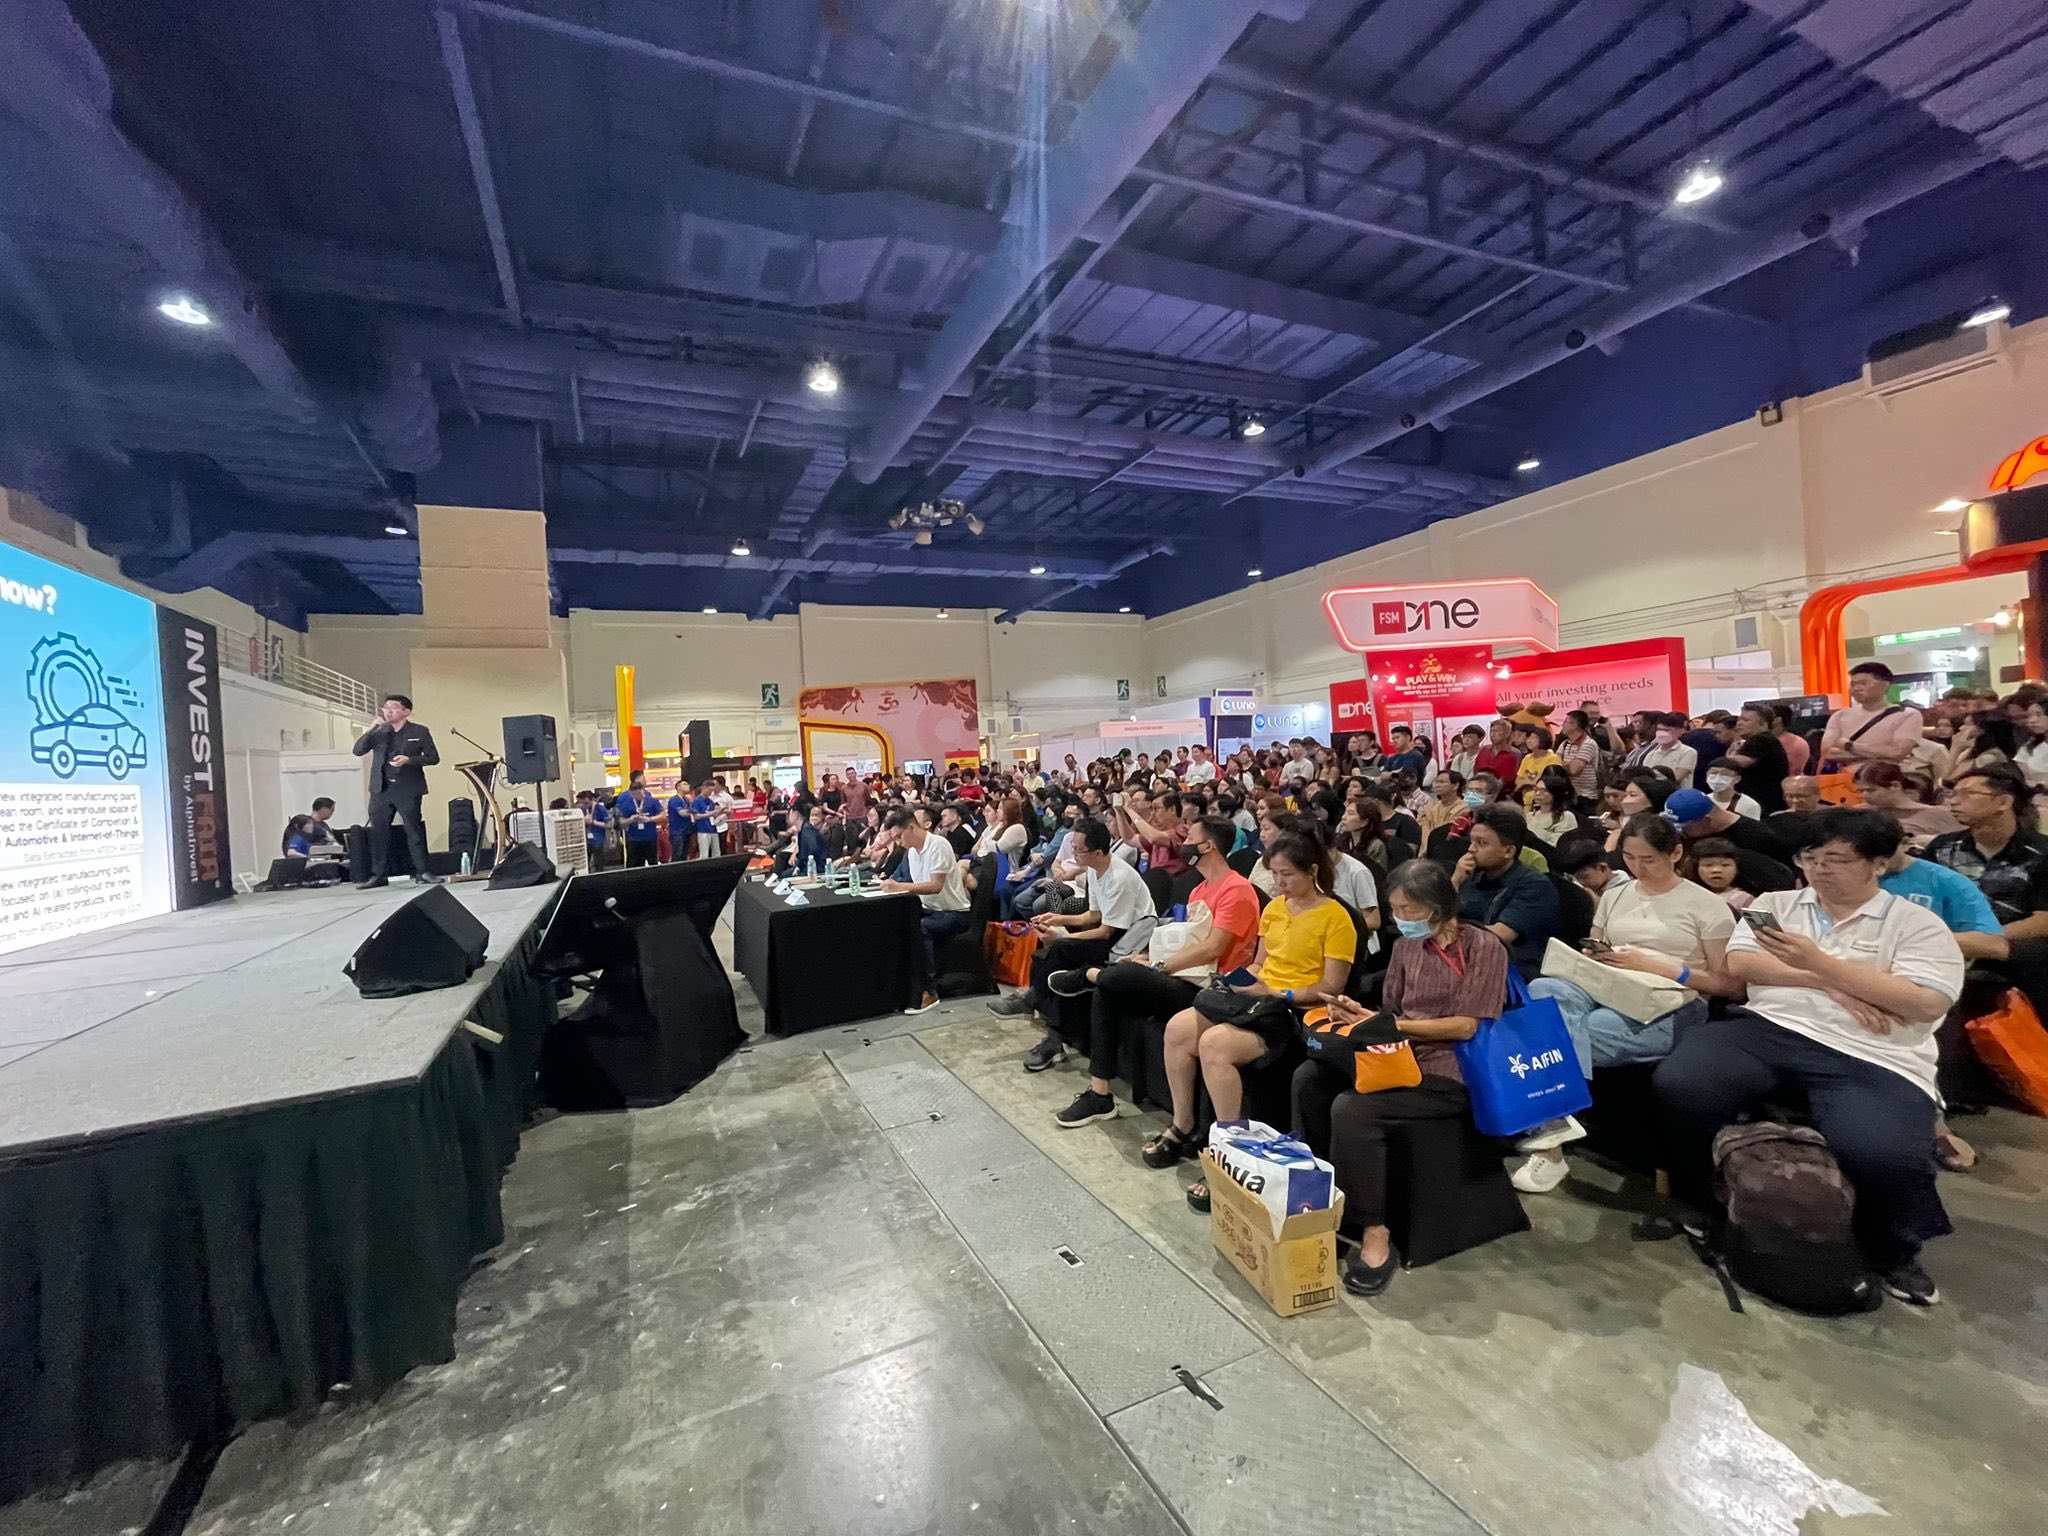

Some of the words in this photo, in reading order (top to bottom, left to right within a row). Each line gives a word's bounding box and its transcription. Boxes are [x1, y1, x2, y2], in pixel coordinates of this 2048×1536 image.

[1379, 612, 1400, 625] FSM
[1497, 692, 1511, 702] All
[1514, 690, 1543, 702] your
[1547, 681, 1607, 696] investing
[1611, 677, 1654, 691] needs
[5, 834, 59, 848] Automotive
